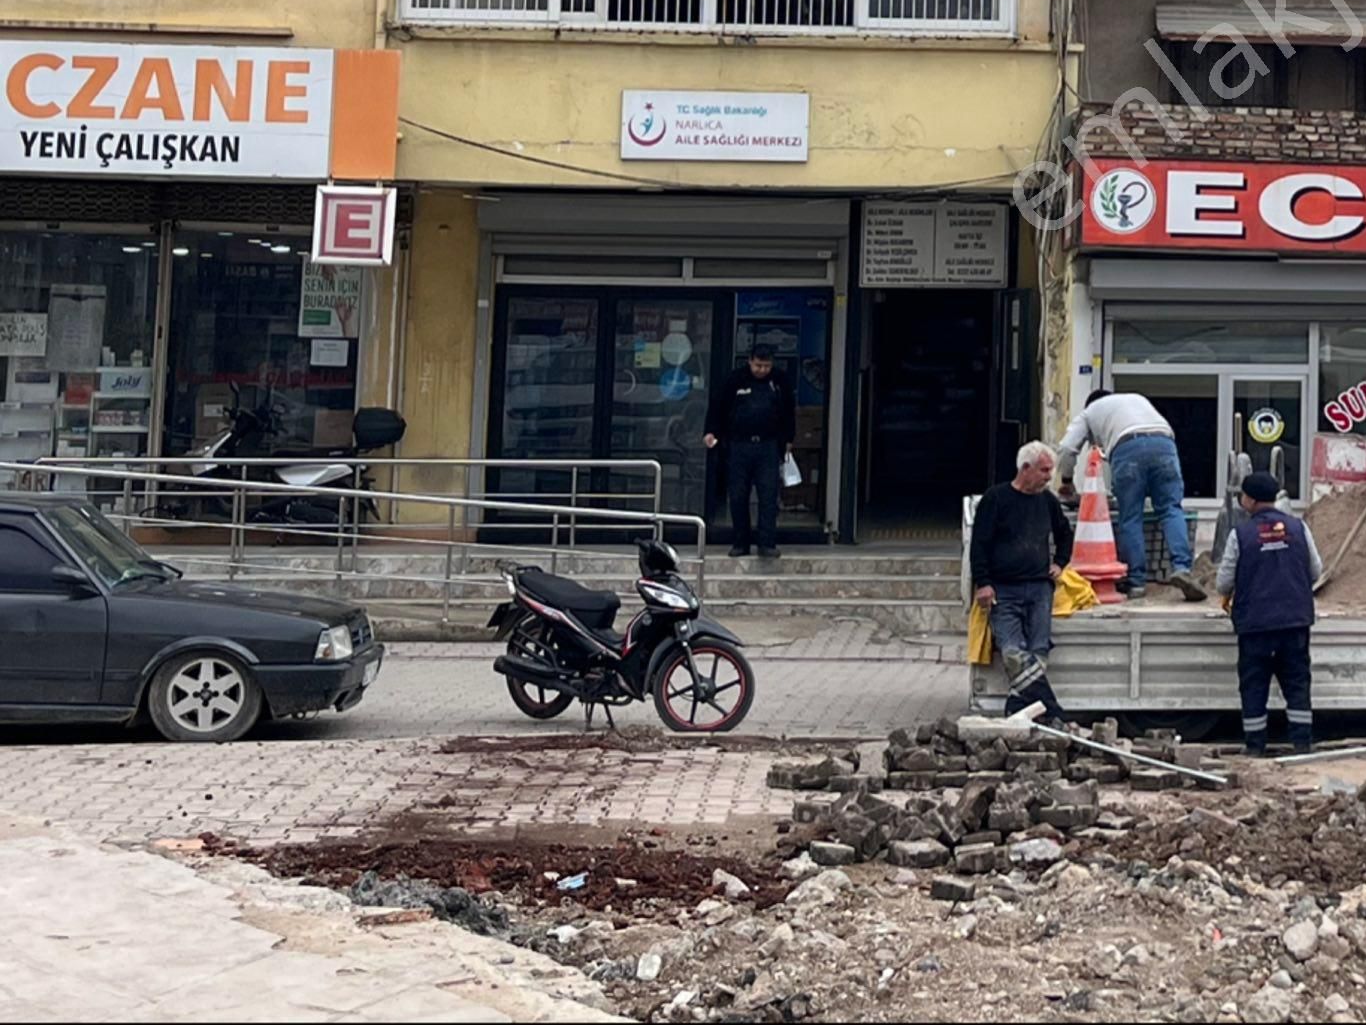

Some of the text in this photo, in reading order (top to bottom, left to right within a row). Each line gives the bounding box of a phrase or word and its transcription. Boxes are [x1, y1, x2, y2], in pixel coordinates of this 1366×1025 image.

[6, 53, 310, 123] CZANE
[20, 125, 240, 168] YENİ ÇALIŞKAN
[703, 134, 749, 145] SAĞLIĞI
[333, 204, 373, 249] E
